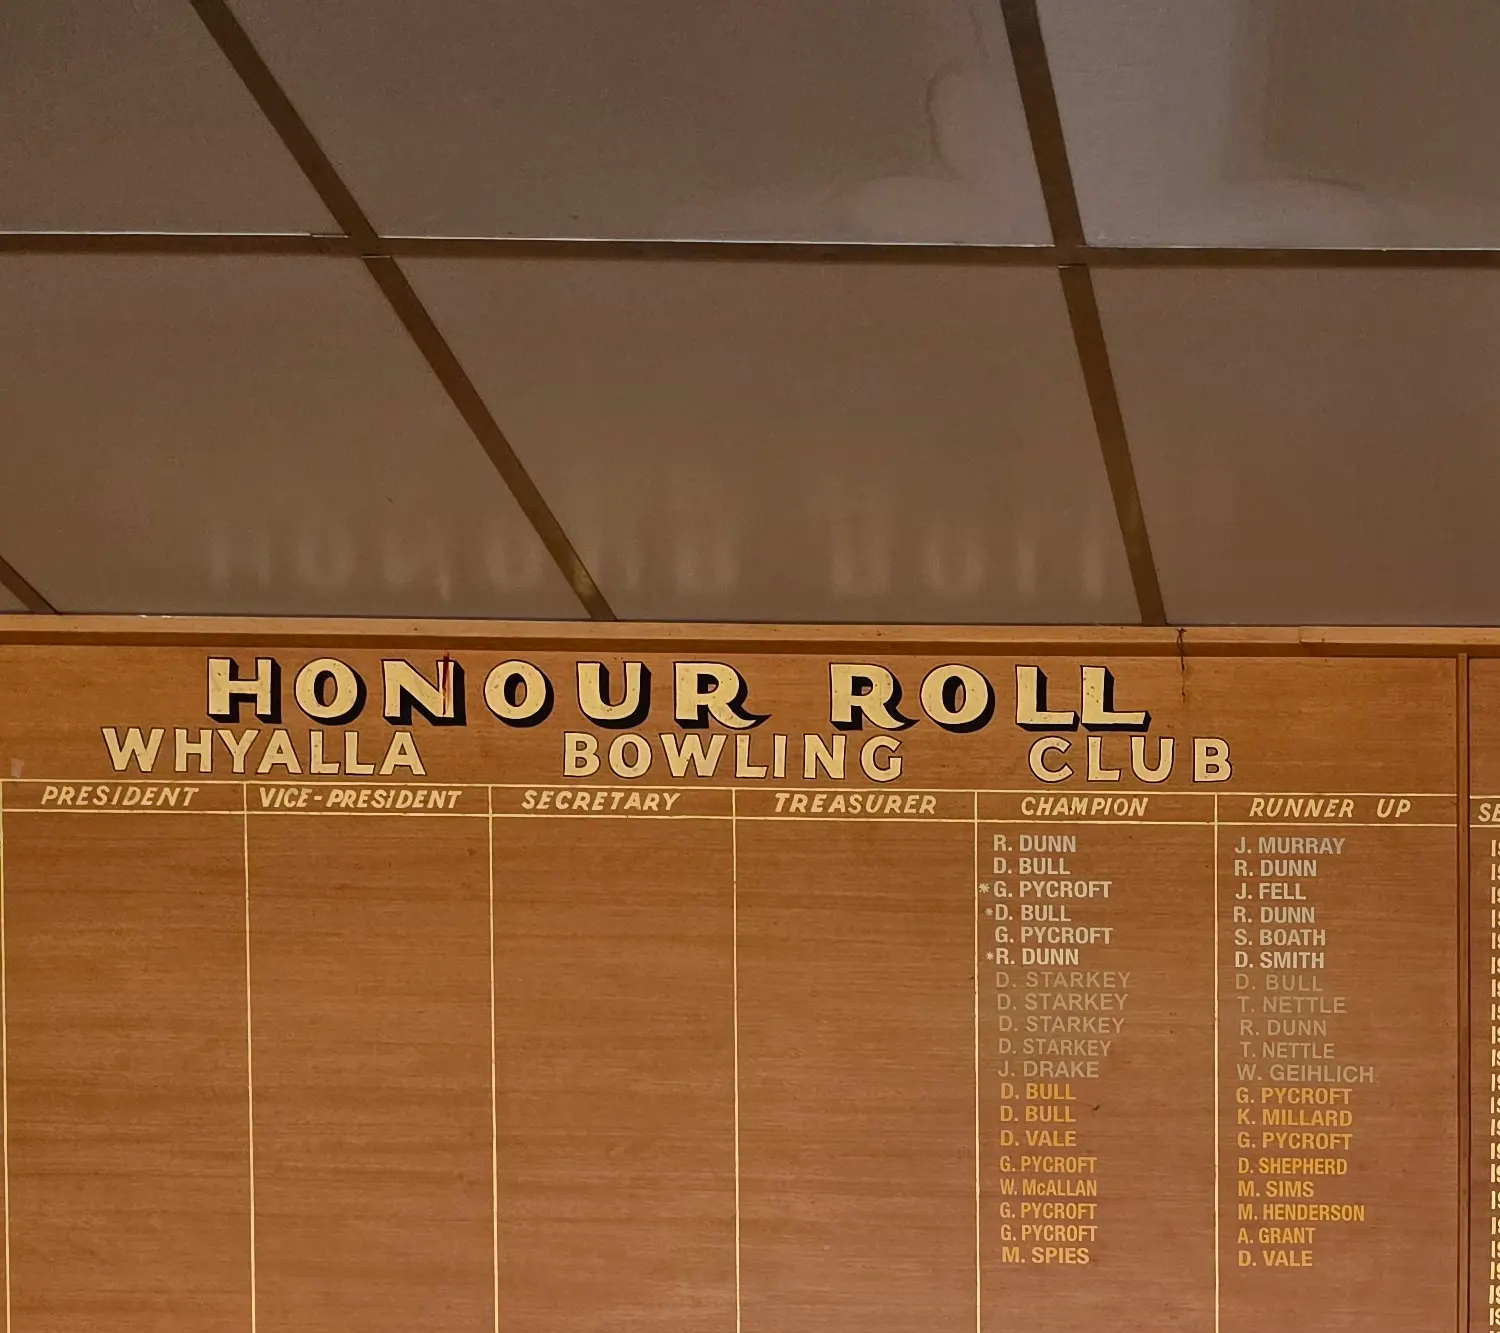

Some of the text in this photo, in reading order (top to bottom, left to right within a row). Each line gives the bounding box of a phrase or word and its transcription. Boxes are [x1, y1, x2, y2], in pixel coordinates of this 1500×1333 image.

[205, 656, 1150, 732] HONOUR ROLL
[102, 725, 1234, 784] WHYALLA BOWLING CLUB
[41, 785, 199, 808] PRESIDENT
[259, 787, 463, 811] VICE-PRESIDENT
[521, 788, 682, 812] SECRETARY
[774, 793, 938, 816] TREASURER
[1020, 797, 1149, 817] CHAMPION
[1249, 798, 1412, 819] RUNNER UP
[994, 835, 1078, 854] R. DUNN
[1235, 837, 1347, 856] J. MURRAY
[994, 858, 1072, 876] D. BULL
[1236, 883, 1308, 901] J. FELL
[1235, 929, 1327, 947] S. BOATH
[1235, 952, 1326, 970] D. SMITH
[998, 1061, 1100, 1079] J. DRAKE
[1238, 1109, 1354, 1128] K. MILLARD
[1238, 1158, 1349, 1176] D. SHEPHERD
[1000, 1179, 1098, 1198] W. McALLAN
[1239, 1204, 1366, 1223] M. HENDERSON
[1002, 1247, 1091, 1266] M. SPIES
